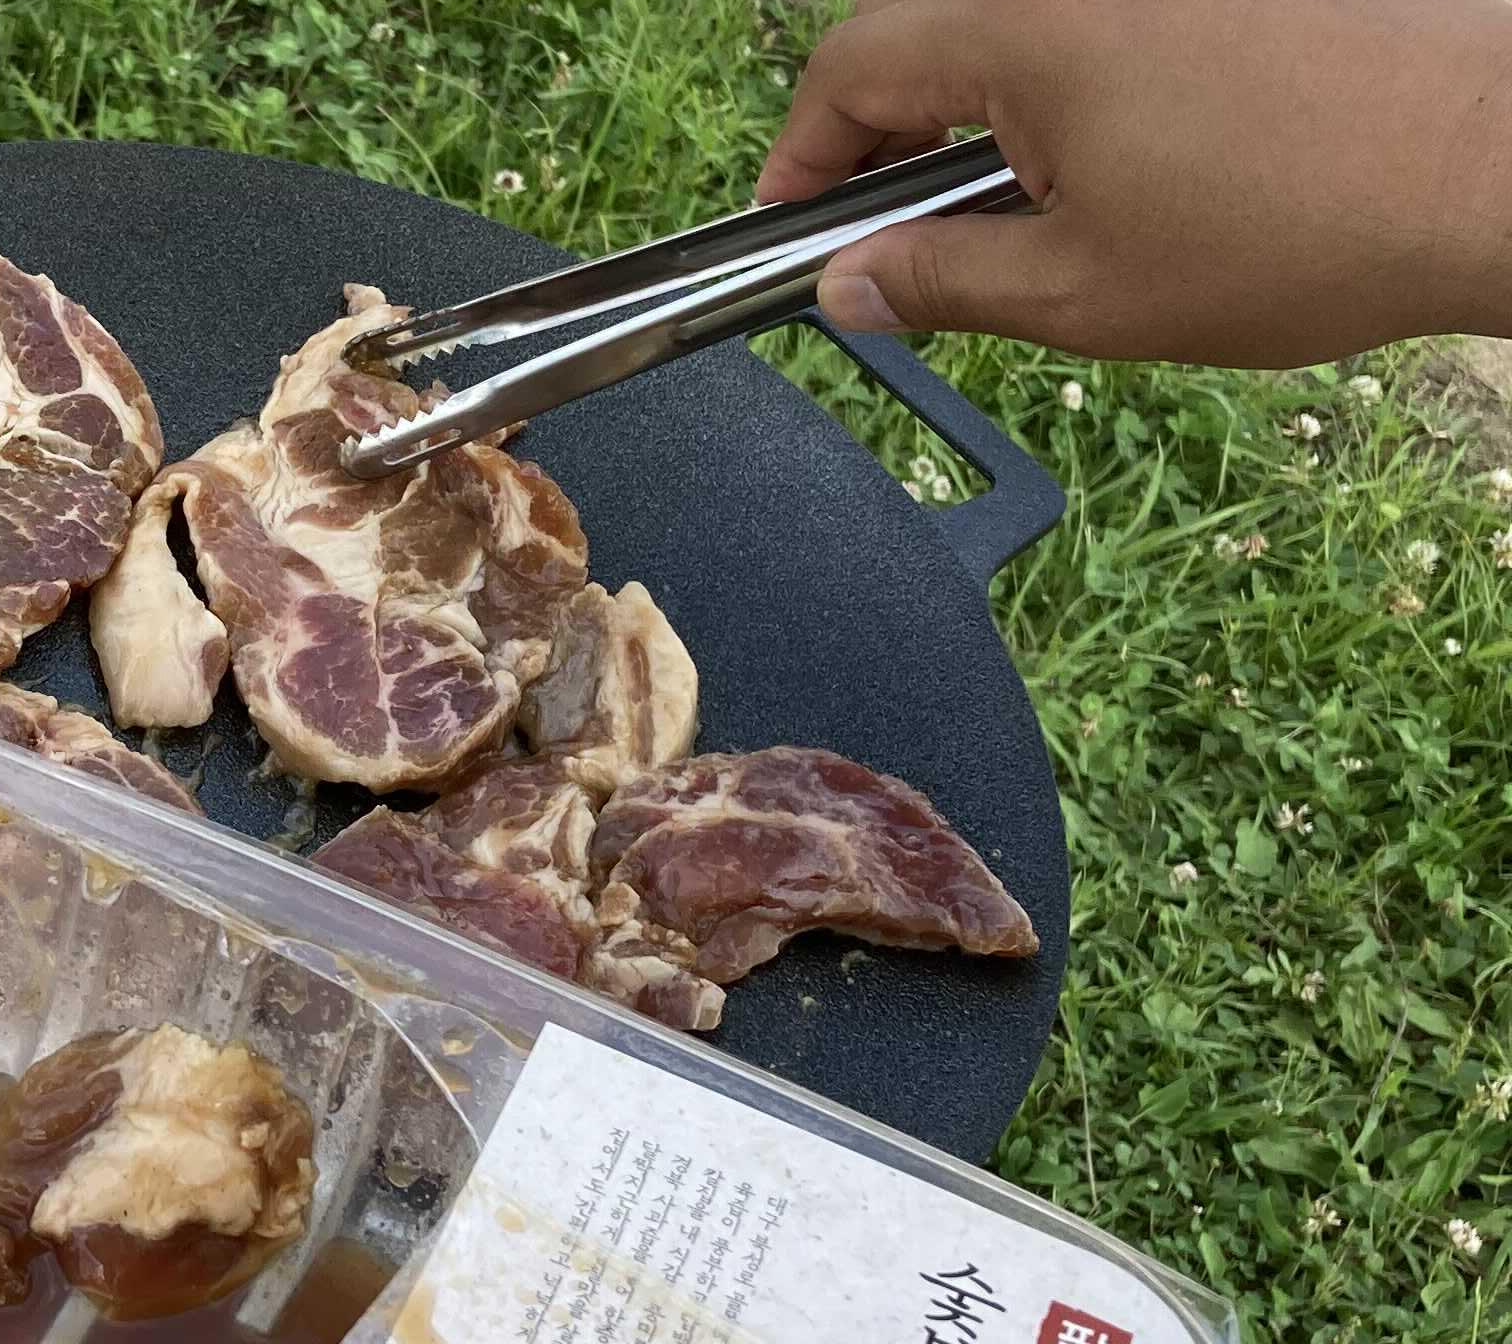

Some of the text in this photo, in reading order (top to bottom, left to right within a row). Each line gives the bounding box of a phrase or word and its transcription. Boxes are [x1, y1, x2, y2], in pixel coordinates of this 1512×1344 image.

[583, 1125, 630, 1197] 집에서도
[662, 1154, 693, 1192] 경북
[629, 1192, 677, 1265] 사과즙을
[677, 1222, 700, 1244] 내
[718, 1180, 757, 1236] 육즙이
[757, 1195, 789, 1233] 대구
[656, 1243, 692, 1290] 식감
[688, 1236, 734, 1305] 풍부하고
[733, 1232, 773, 1288] 북성로
